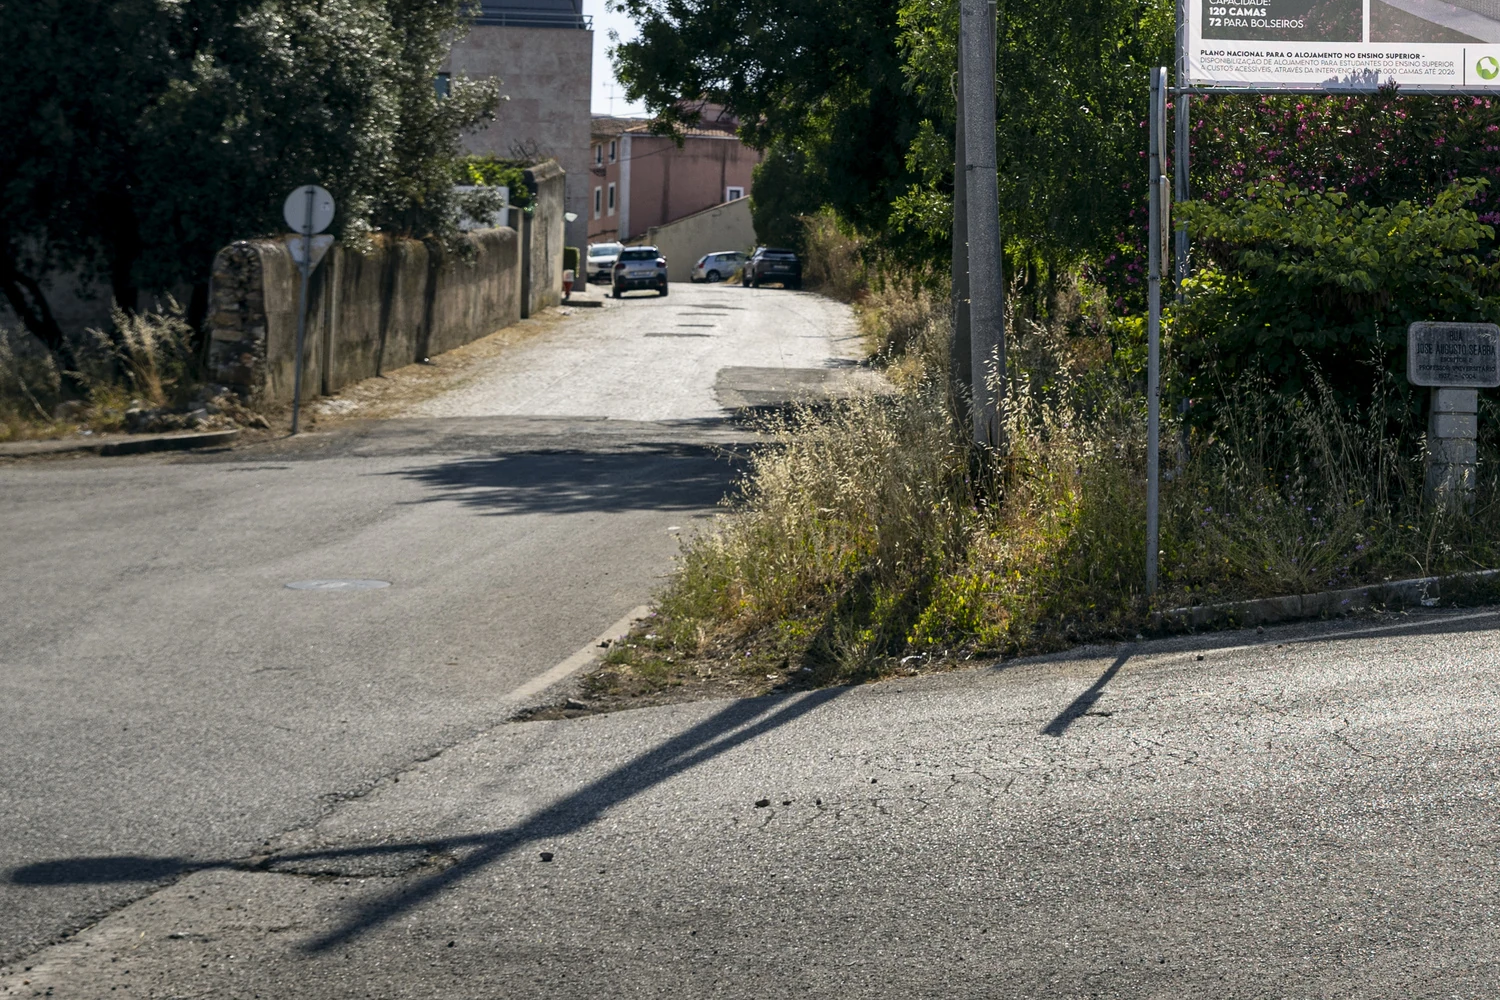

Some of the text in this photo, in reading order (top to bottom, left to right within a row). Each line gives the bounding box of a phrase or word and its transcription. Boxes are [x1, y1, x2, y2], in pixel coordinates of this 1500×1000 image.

[1209, 7, 1267, 17] 120 CAMAS
[1208, 18, 1304, 29] 72 PARA BOLSEIROS
[1200, 57, 1262, 66] DISPONIBILIZAÇÃO
[1235, 64, 1273, 73] ACESSÍVEIS,
[1274, 65, 1303, 73] ATRAVÉS
[1449, 331, 1463, 341] RUA
[1435, 343, 1467, 355] AUGUSTO
[1468, 345, 1496, 356] SEABRA
